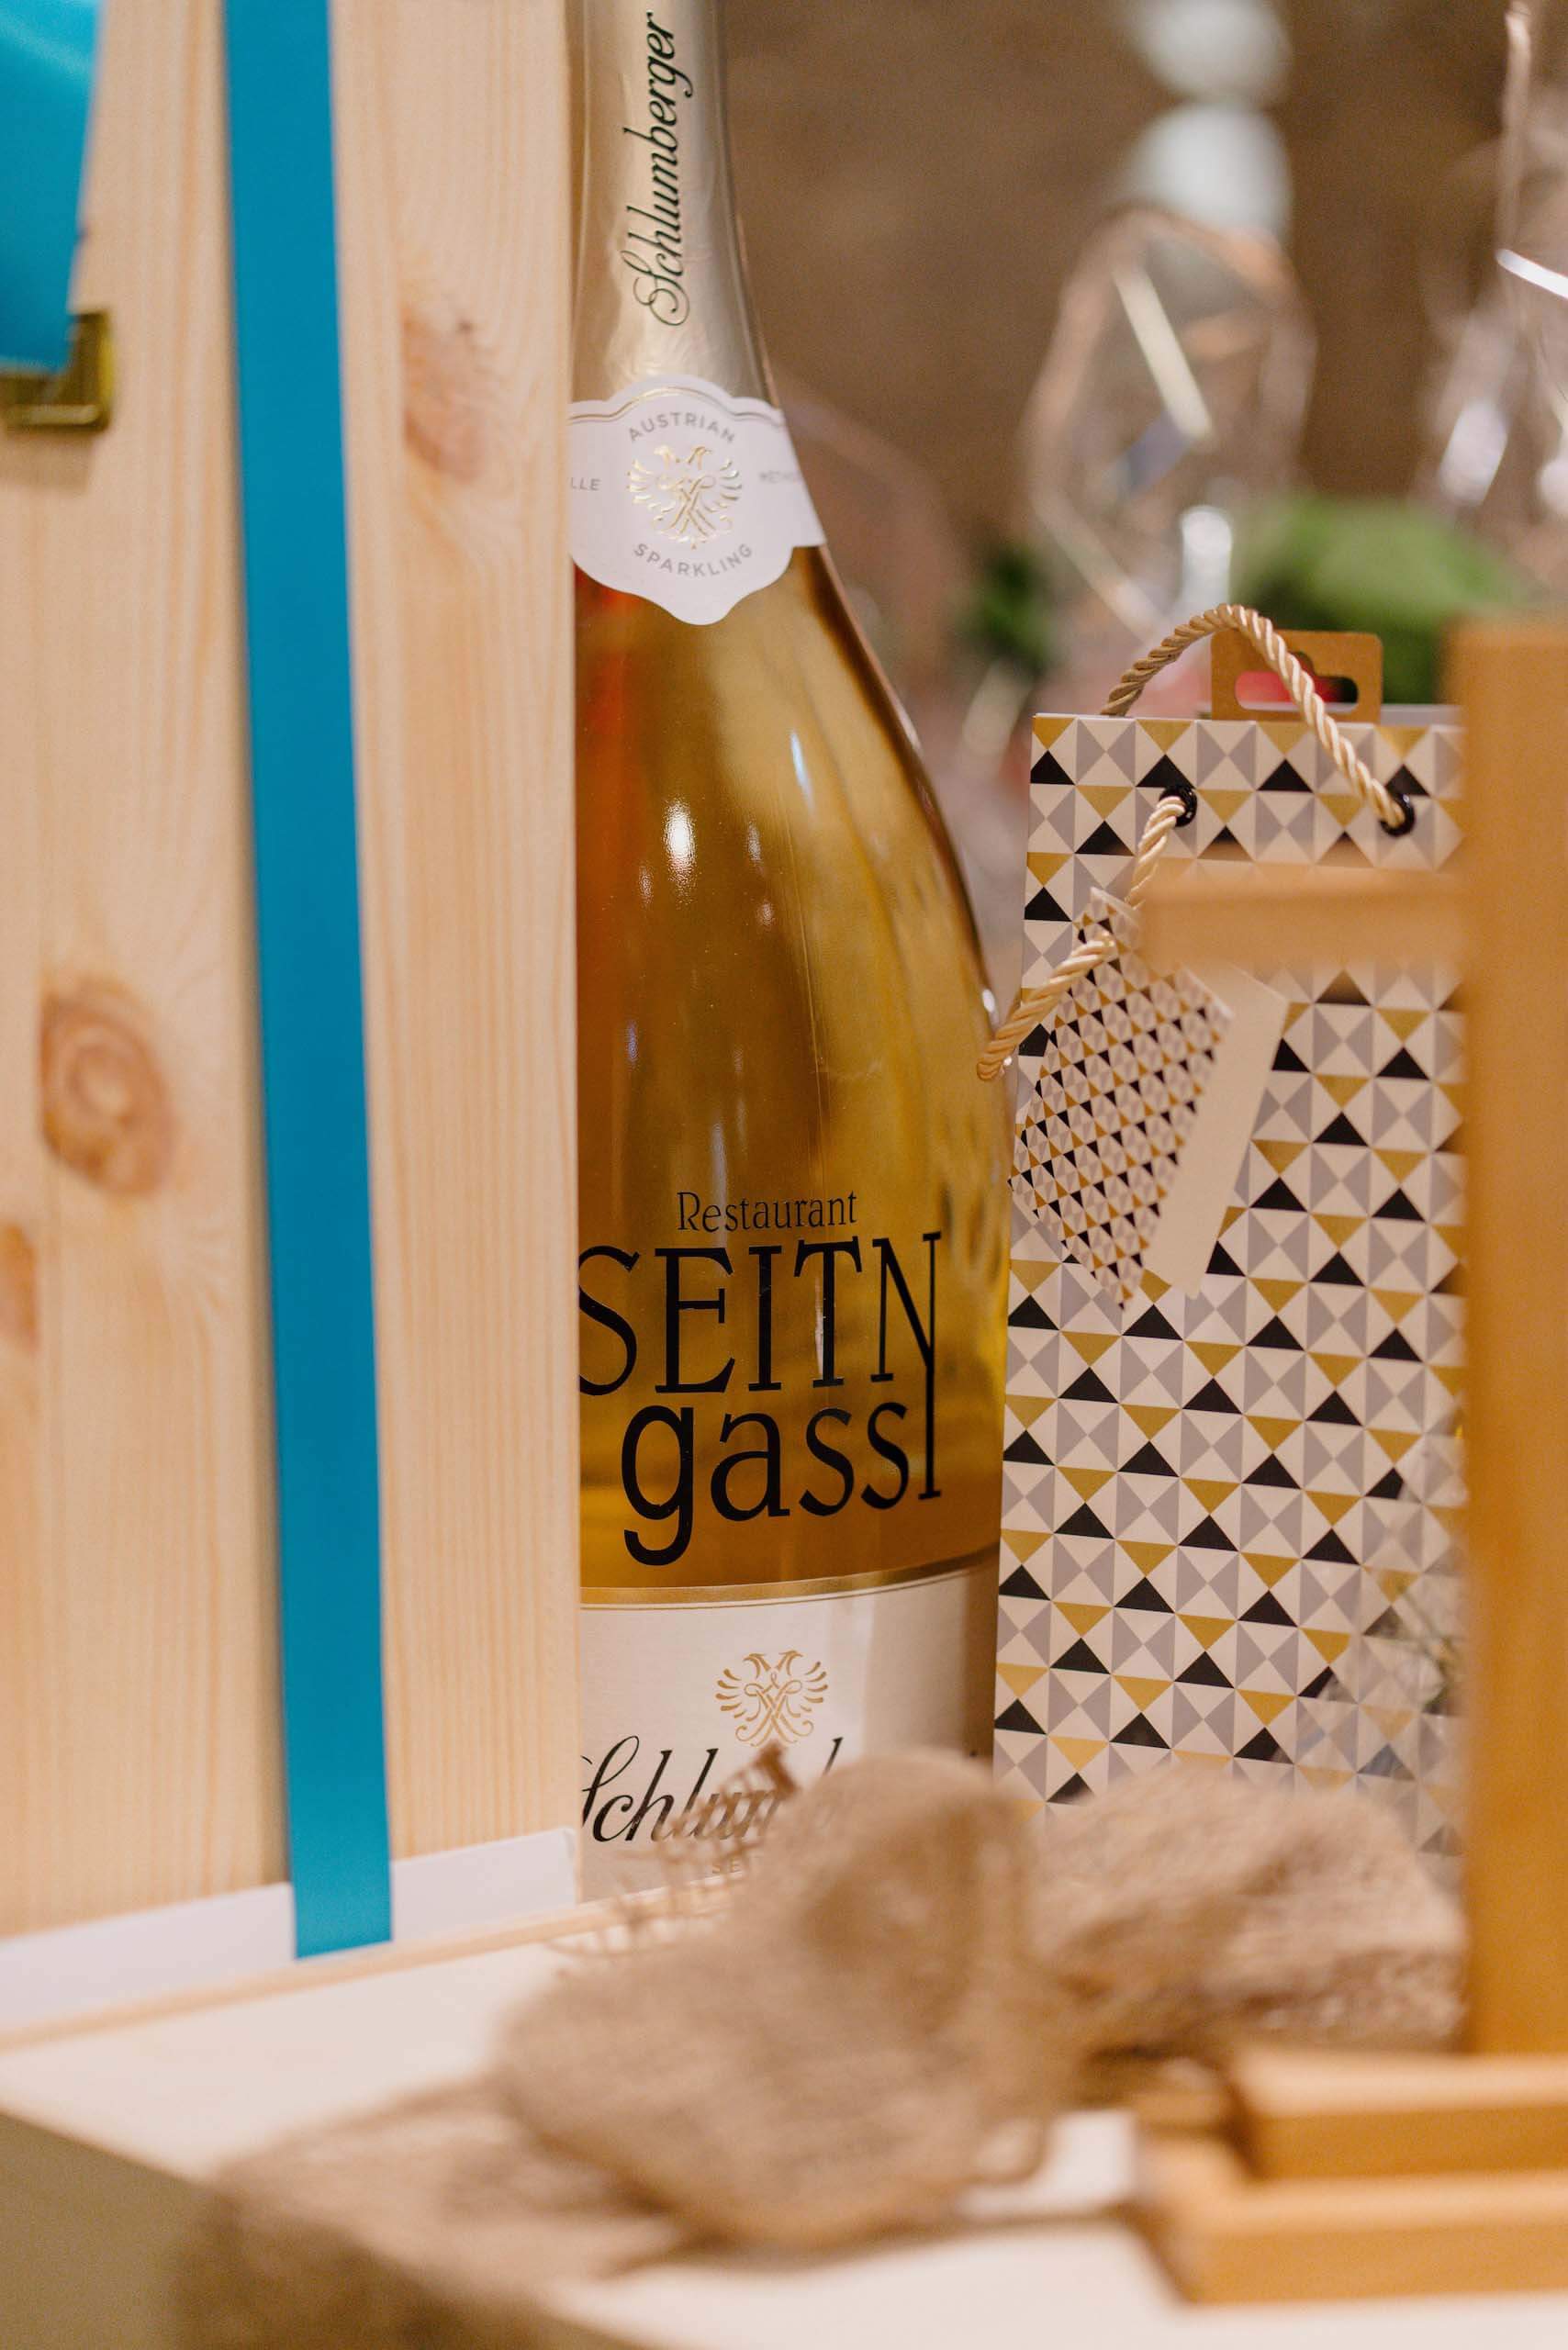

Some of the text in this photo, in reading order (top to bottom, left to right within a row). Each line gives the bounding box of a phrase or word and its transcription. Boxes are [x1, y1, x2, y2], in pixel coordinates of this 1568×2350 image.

[620, 11, 693, 326] Schlumberger
[629, 412, 735, 443] AUSTRIAN
[633, 543, 753, 577] SPARKLING
[677, 1191, 857, 1232] Restaurant
[579, 1232, 942, 1396] SEITN
